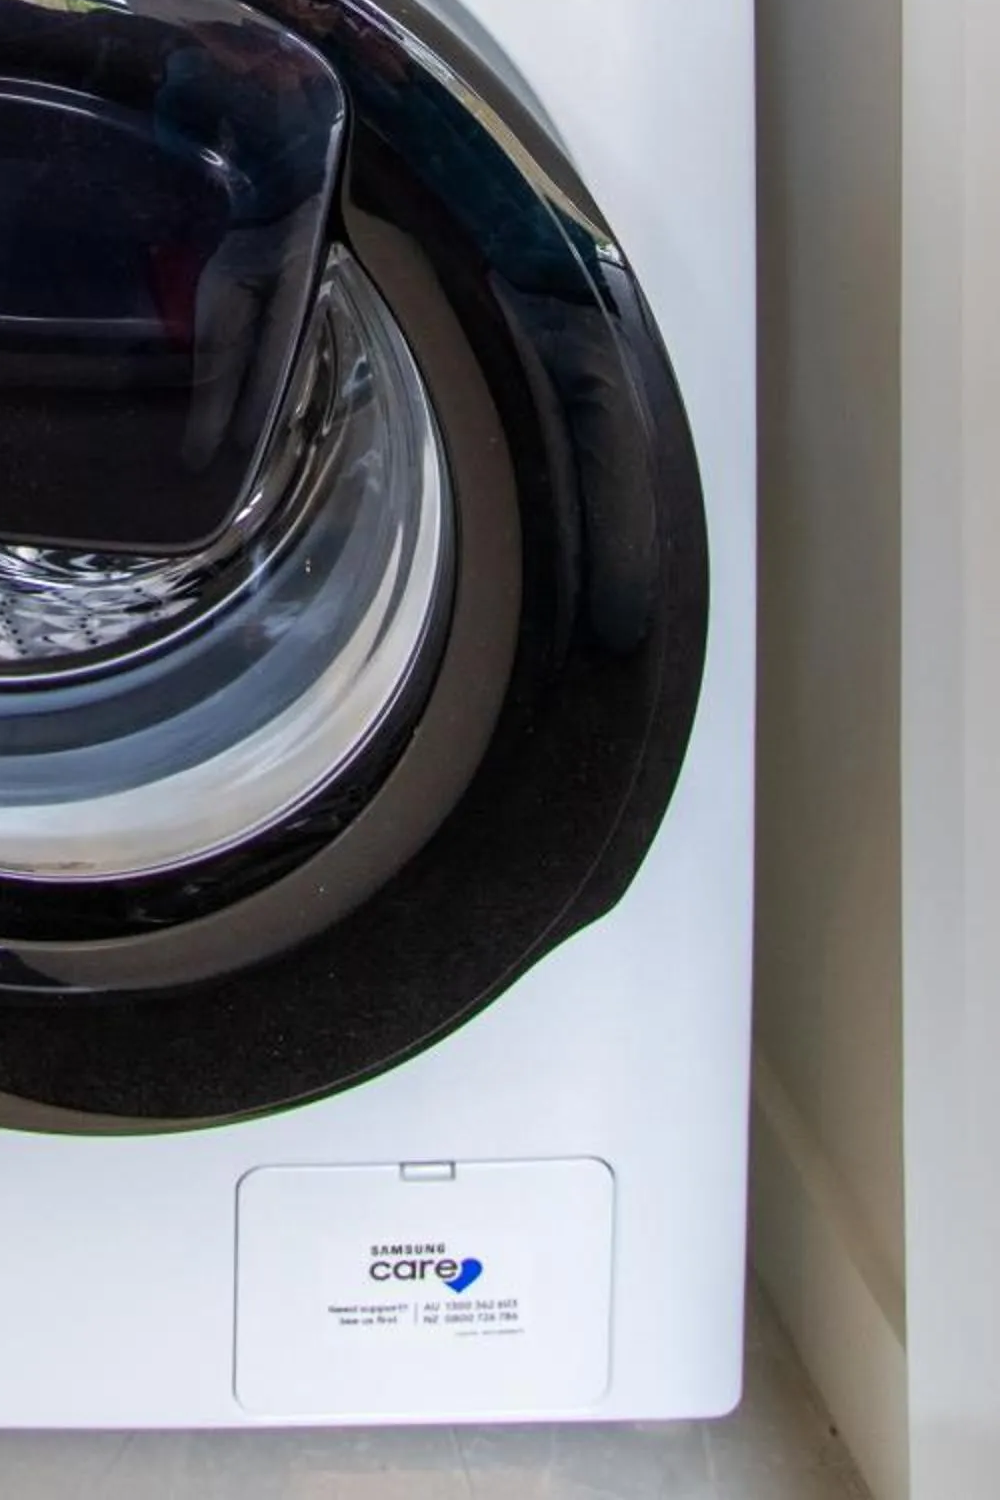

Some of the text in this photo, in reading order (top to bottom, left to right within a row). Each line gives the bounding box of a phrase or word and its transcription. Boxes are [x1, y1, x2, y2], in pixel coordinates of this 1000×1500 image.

[370, 1243, 446, 1256] SAMSUNG
[369, 1258, 458, 1281] care
[423, 1302, 440, 1311] AU
[423, 1314, 439, 1324] NZ
